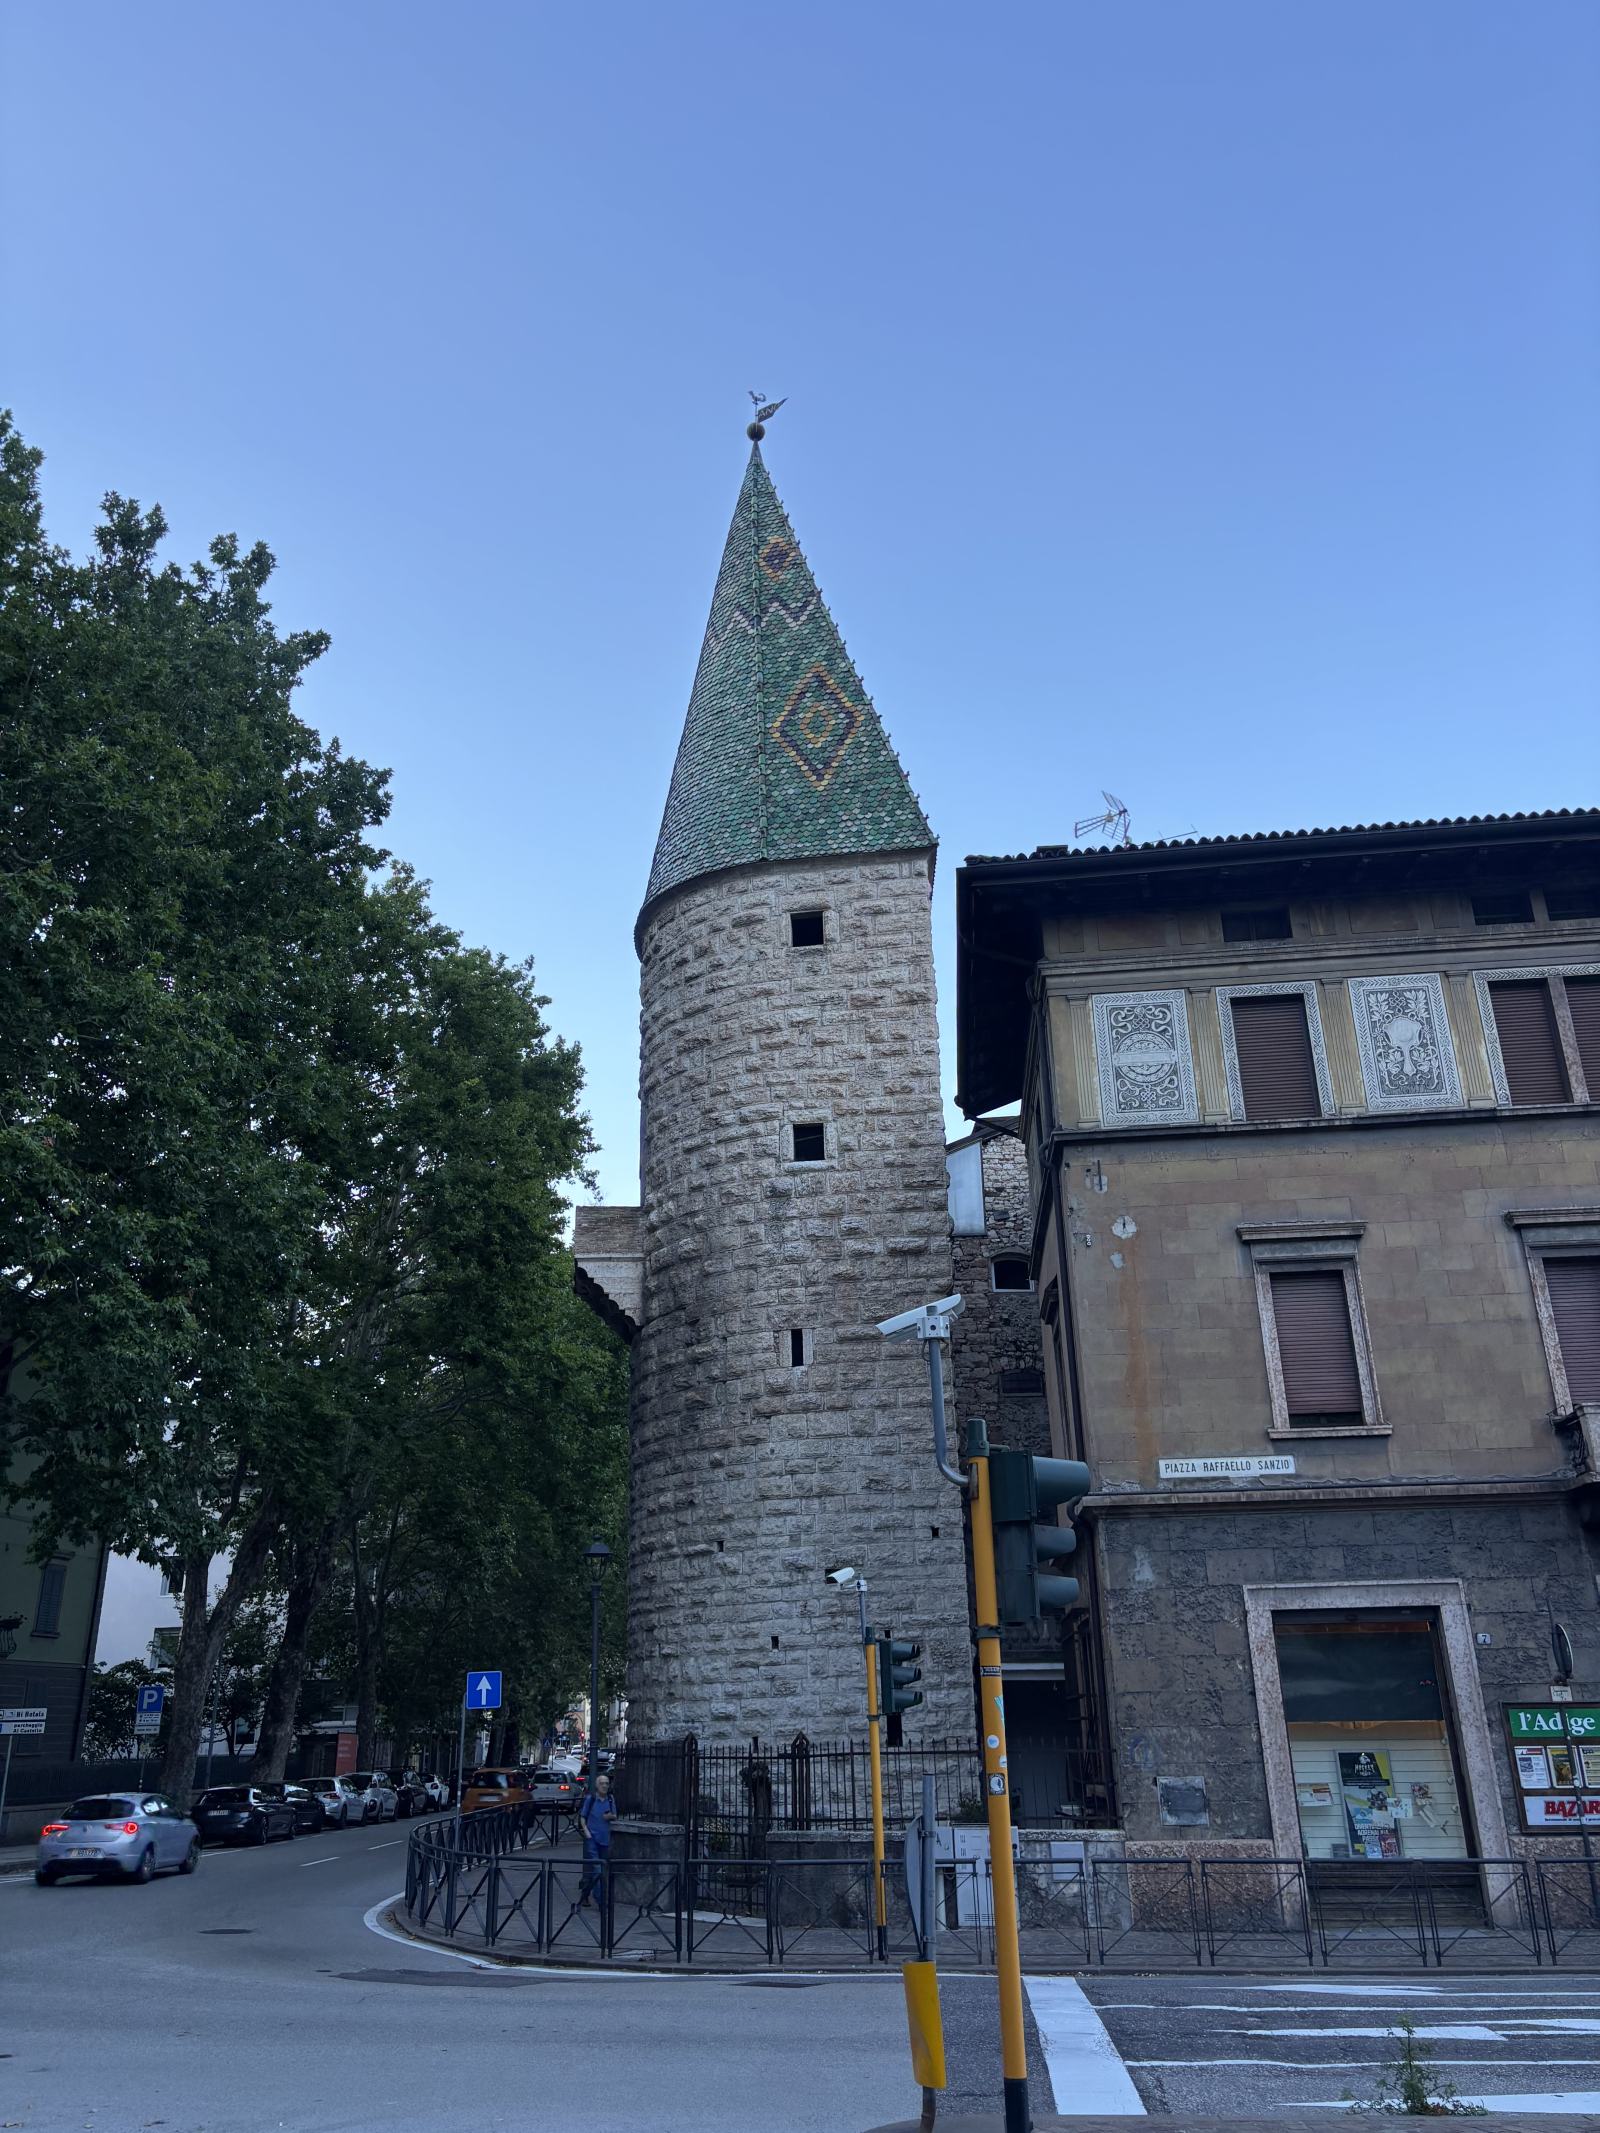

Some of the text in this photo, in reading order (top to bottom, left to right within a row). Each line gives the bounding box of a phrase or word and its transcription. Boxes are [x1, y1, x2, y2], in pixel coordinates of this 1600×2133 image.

[1164, 1459, 1290, 1474] PIAZZA RAFFAELLO SANZIO
[142, 1690, 158, 1710] P
